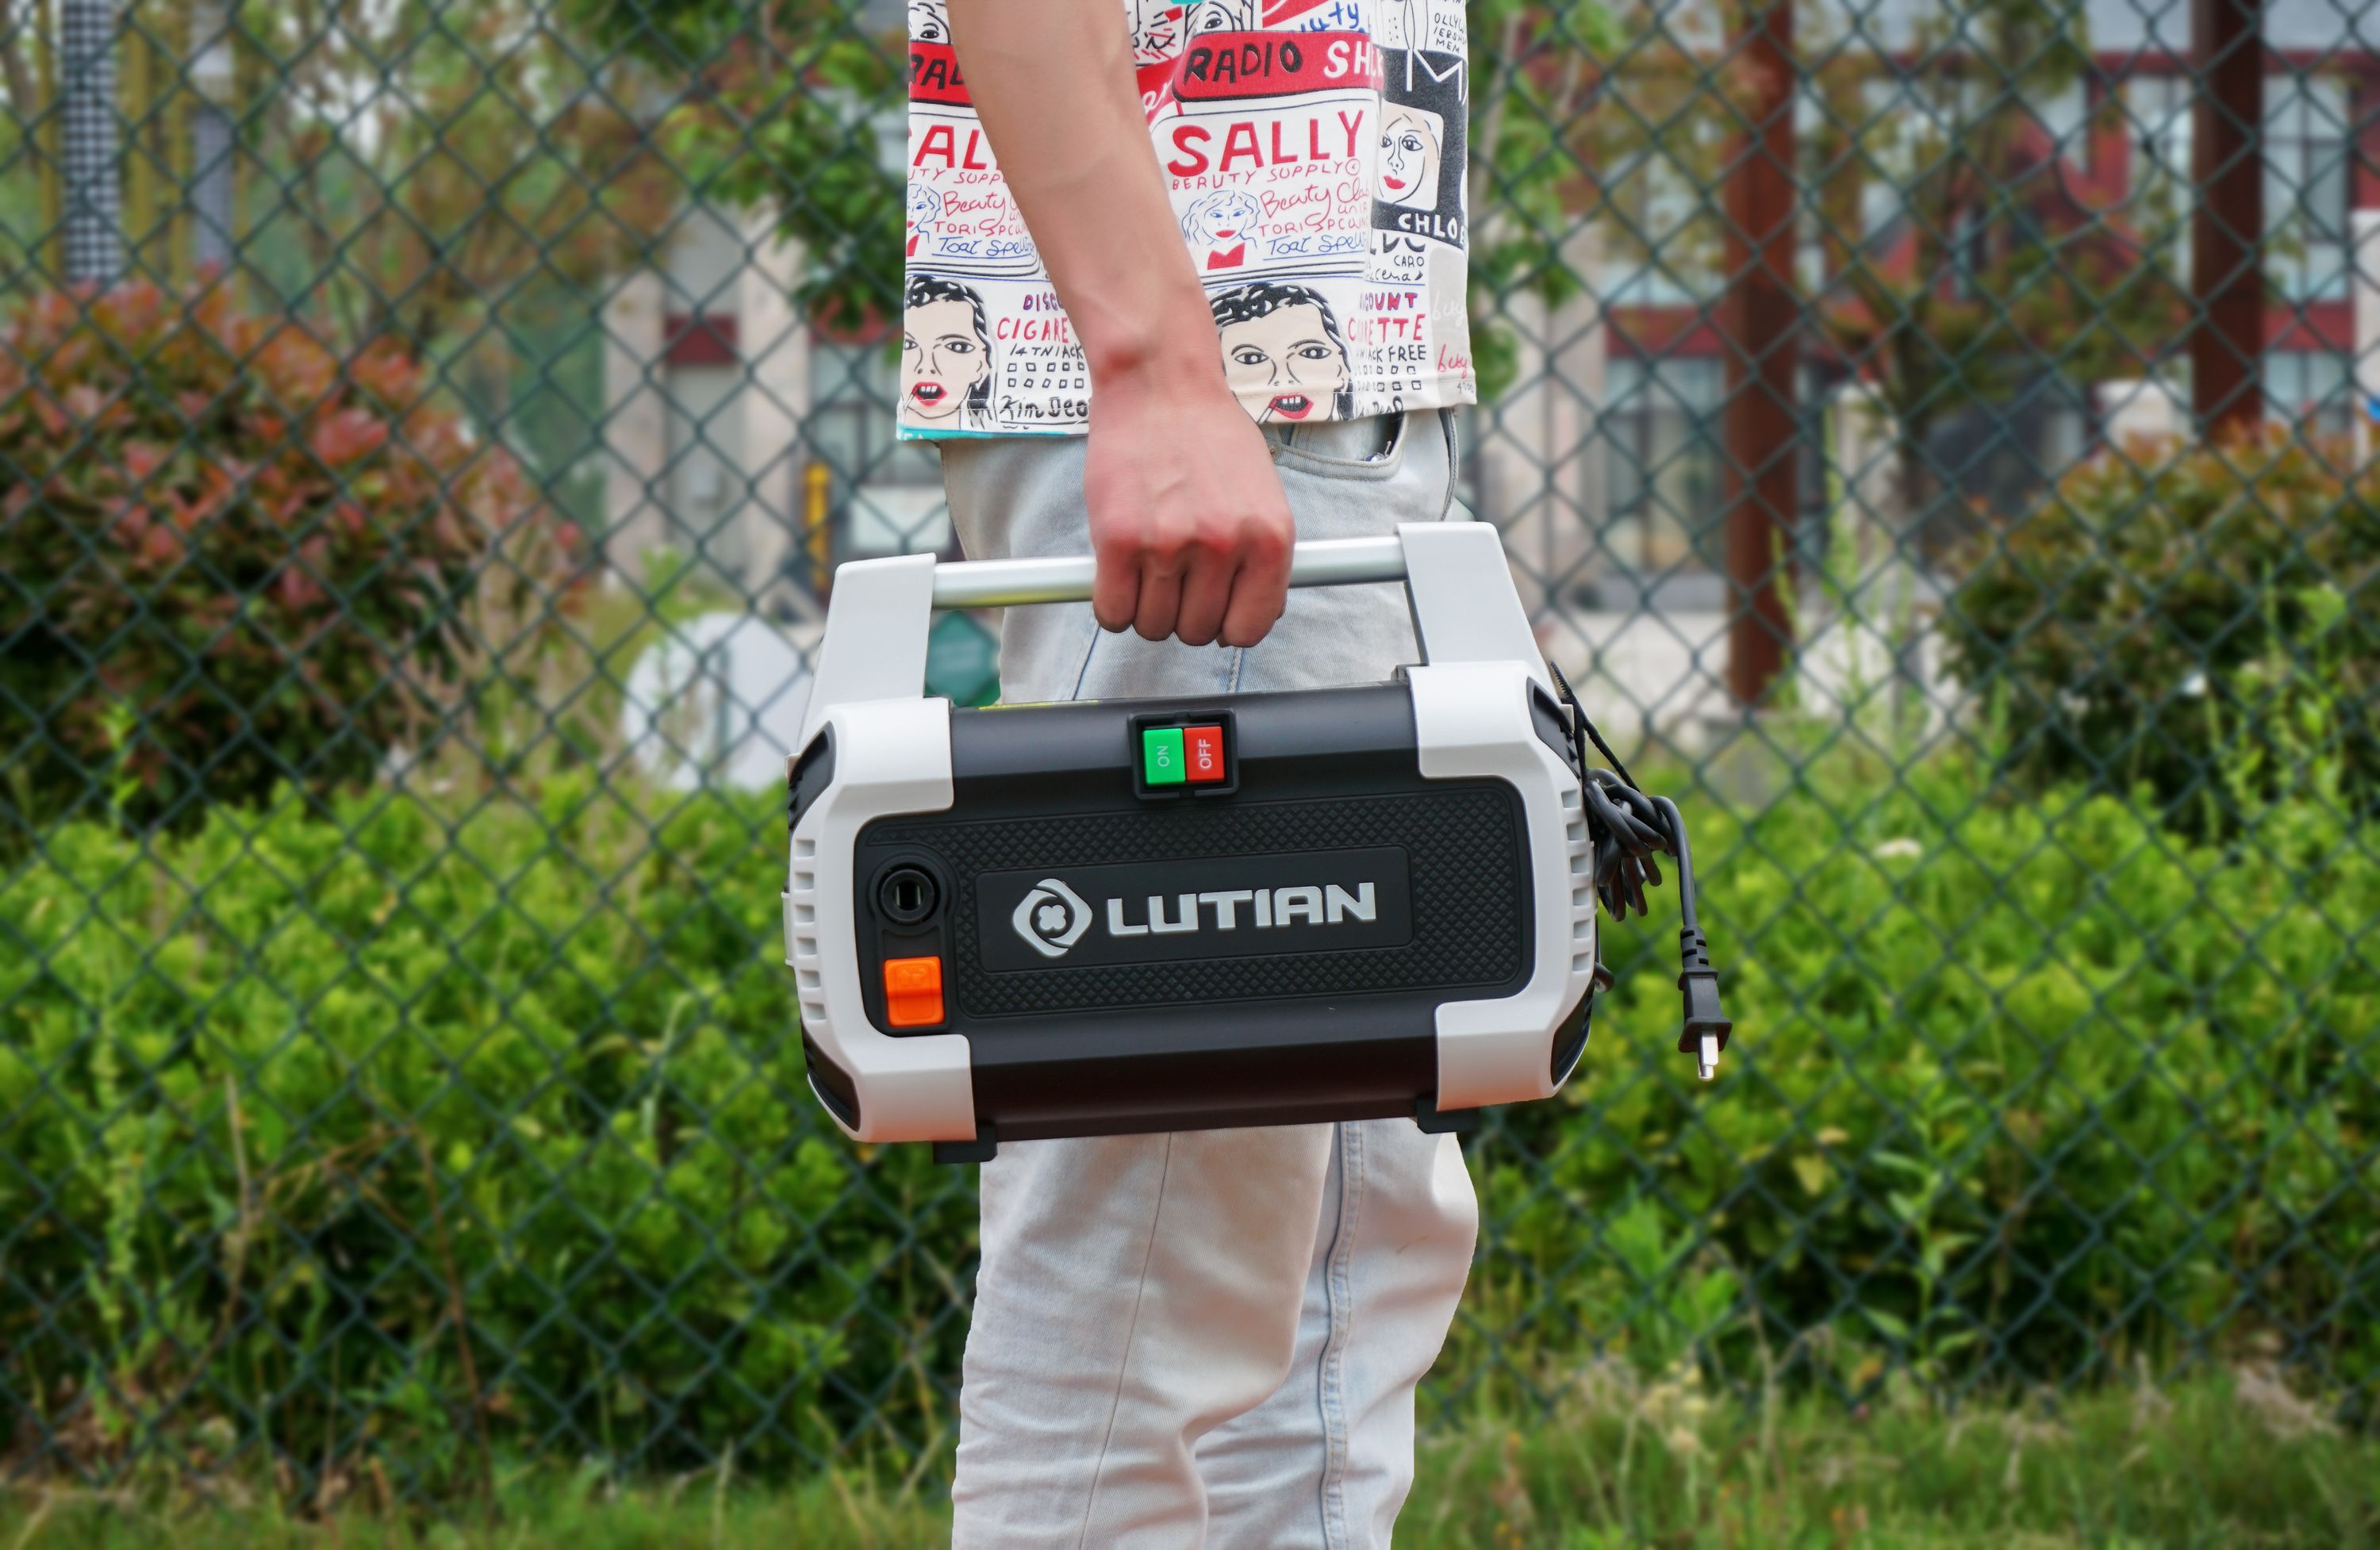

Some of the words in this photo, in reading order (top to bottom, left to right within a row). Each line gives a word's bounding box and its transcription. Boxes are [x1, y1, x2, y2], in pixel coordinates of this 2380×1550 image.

[1184, 40, 1303, 87] RADIO
[1167, 109, 1364, 178] SALLY
[1266, 163, 1343, 182] SUPPLY
[1388, 343, 1427, 363] FREE
[1157, 745, 1170, 767] ON
[1199, 739, 1212, 769] OFF
[1107, 882, 1376, 935] LUTIAN
